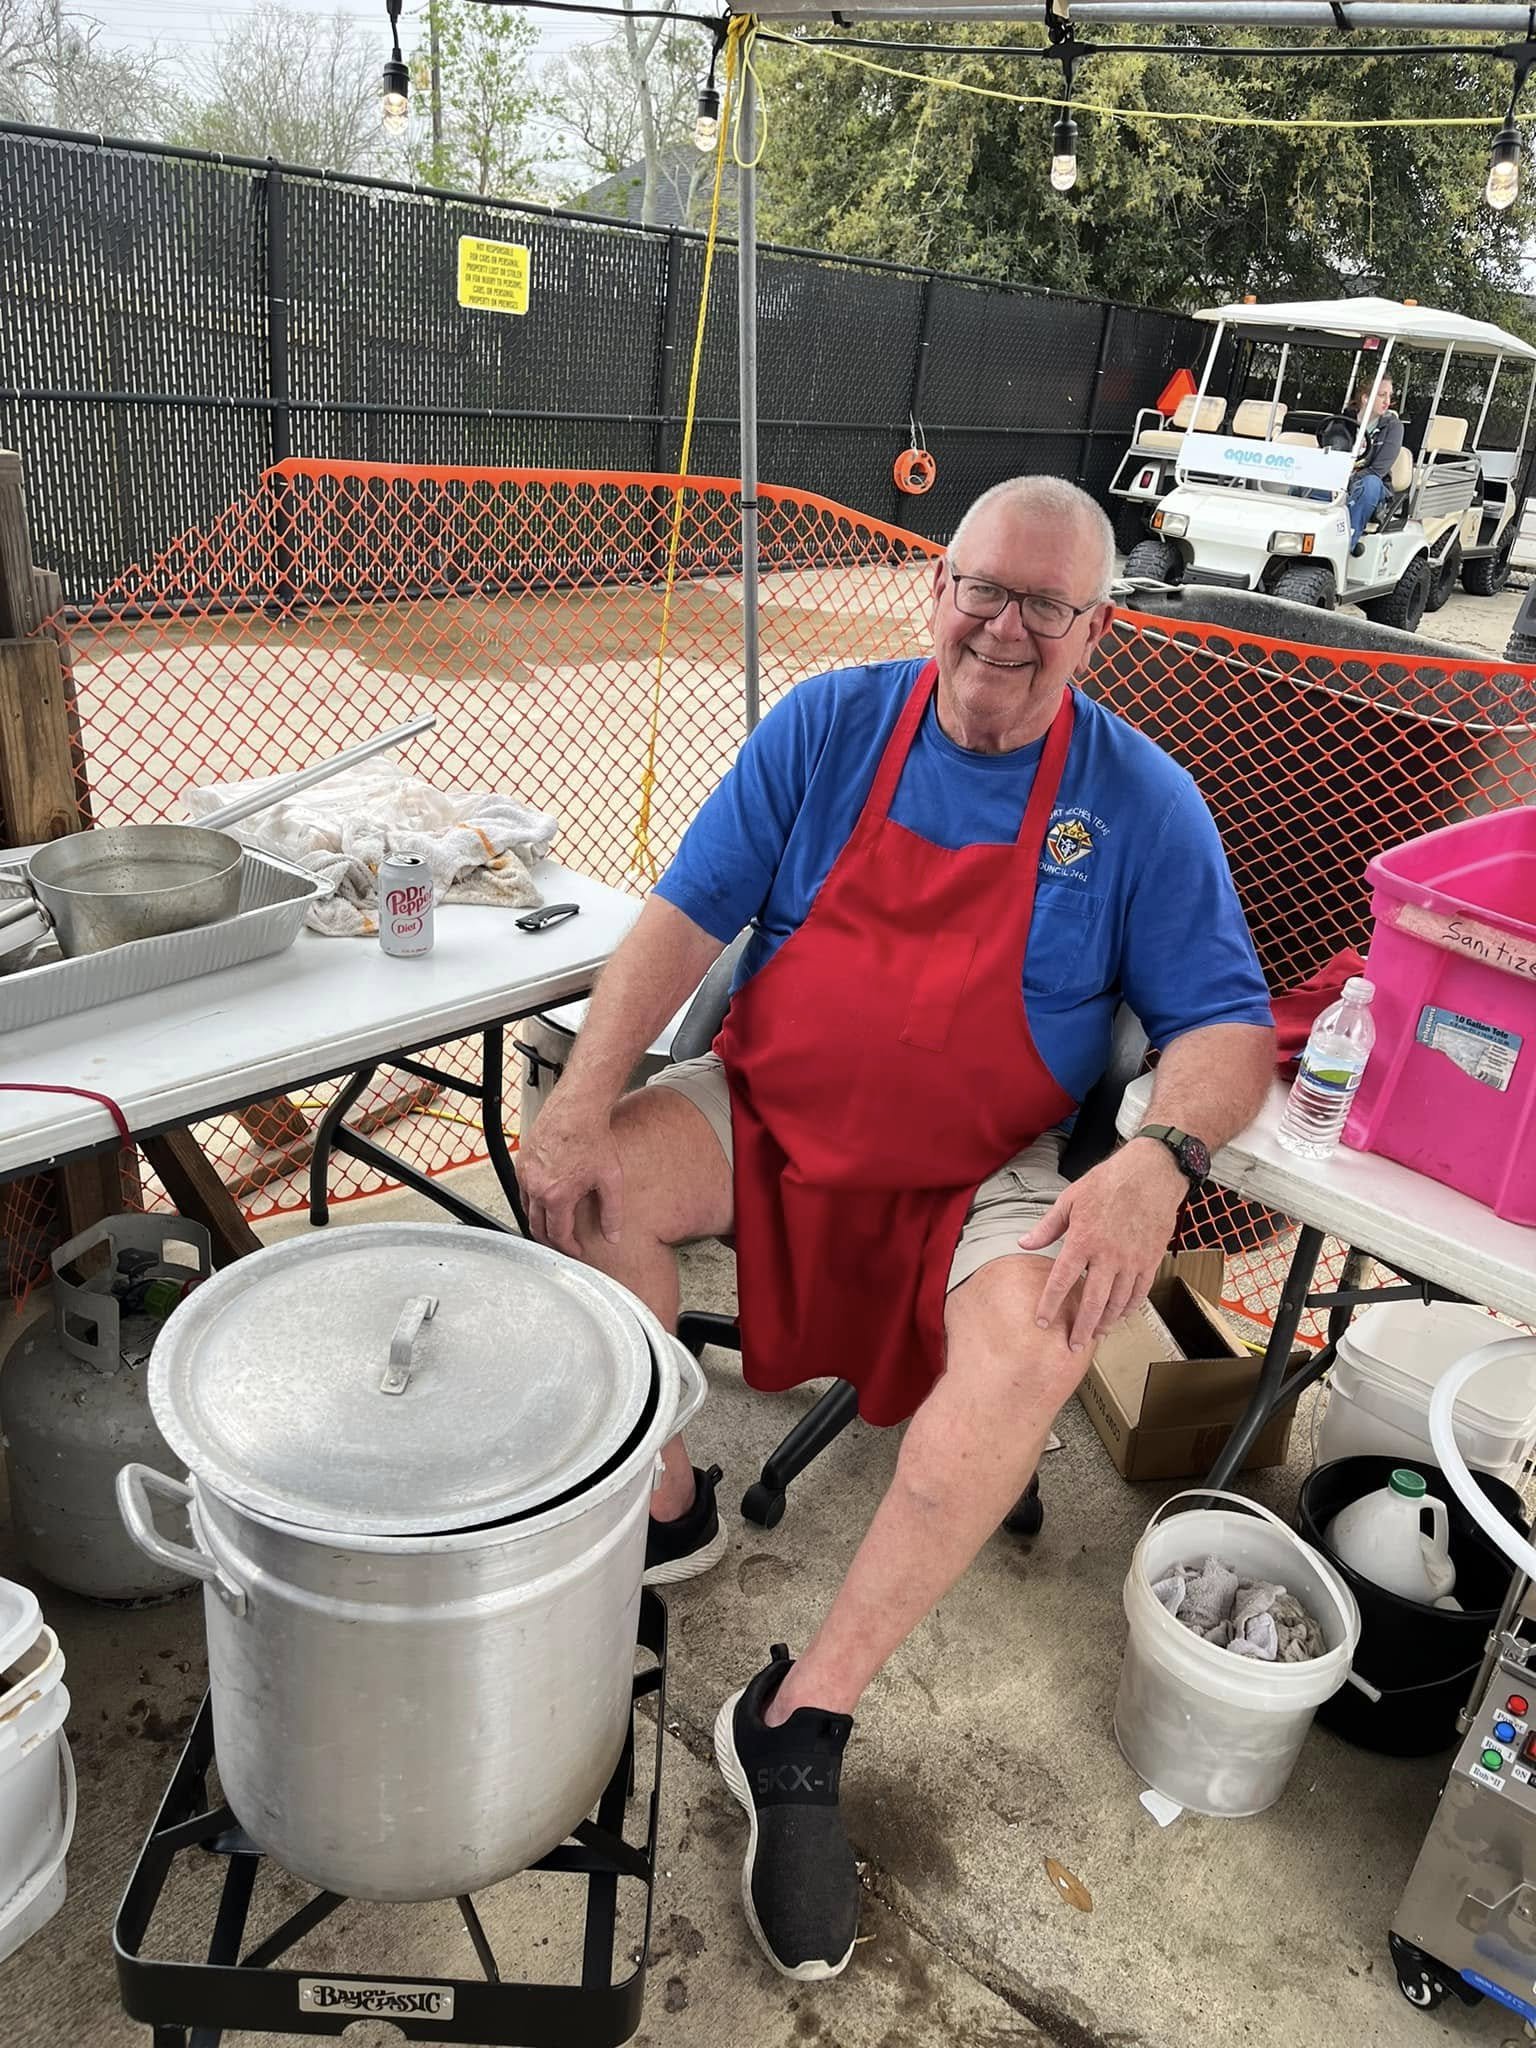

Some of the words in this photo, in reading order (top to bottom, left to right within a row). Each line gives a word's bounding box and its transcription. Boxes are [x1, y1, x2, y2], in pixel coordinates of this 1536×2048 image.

[466, 262, 488, 273] PROPERTY
[1224, 448, 1262, 464] aqua
[1265, 454, 1295, 468] one
[406, 885, 425, 902] Dr
[386, 890, 432, 916] Pepper
[397, 922, 416, 934] Diet
[1455, 1015, 1465, 1024] 10
[1465, 1017, 1490, 1032] Gallon
[1492, 1027, 1509, 1039] Tote
